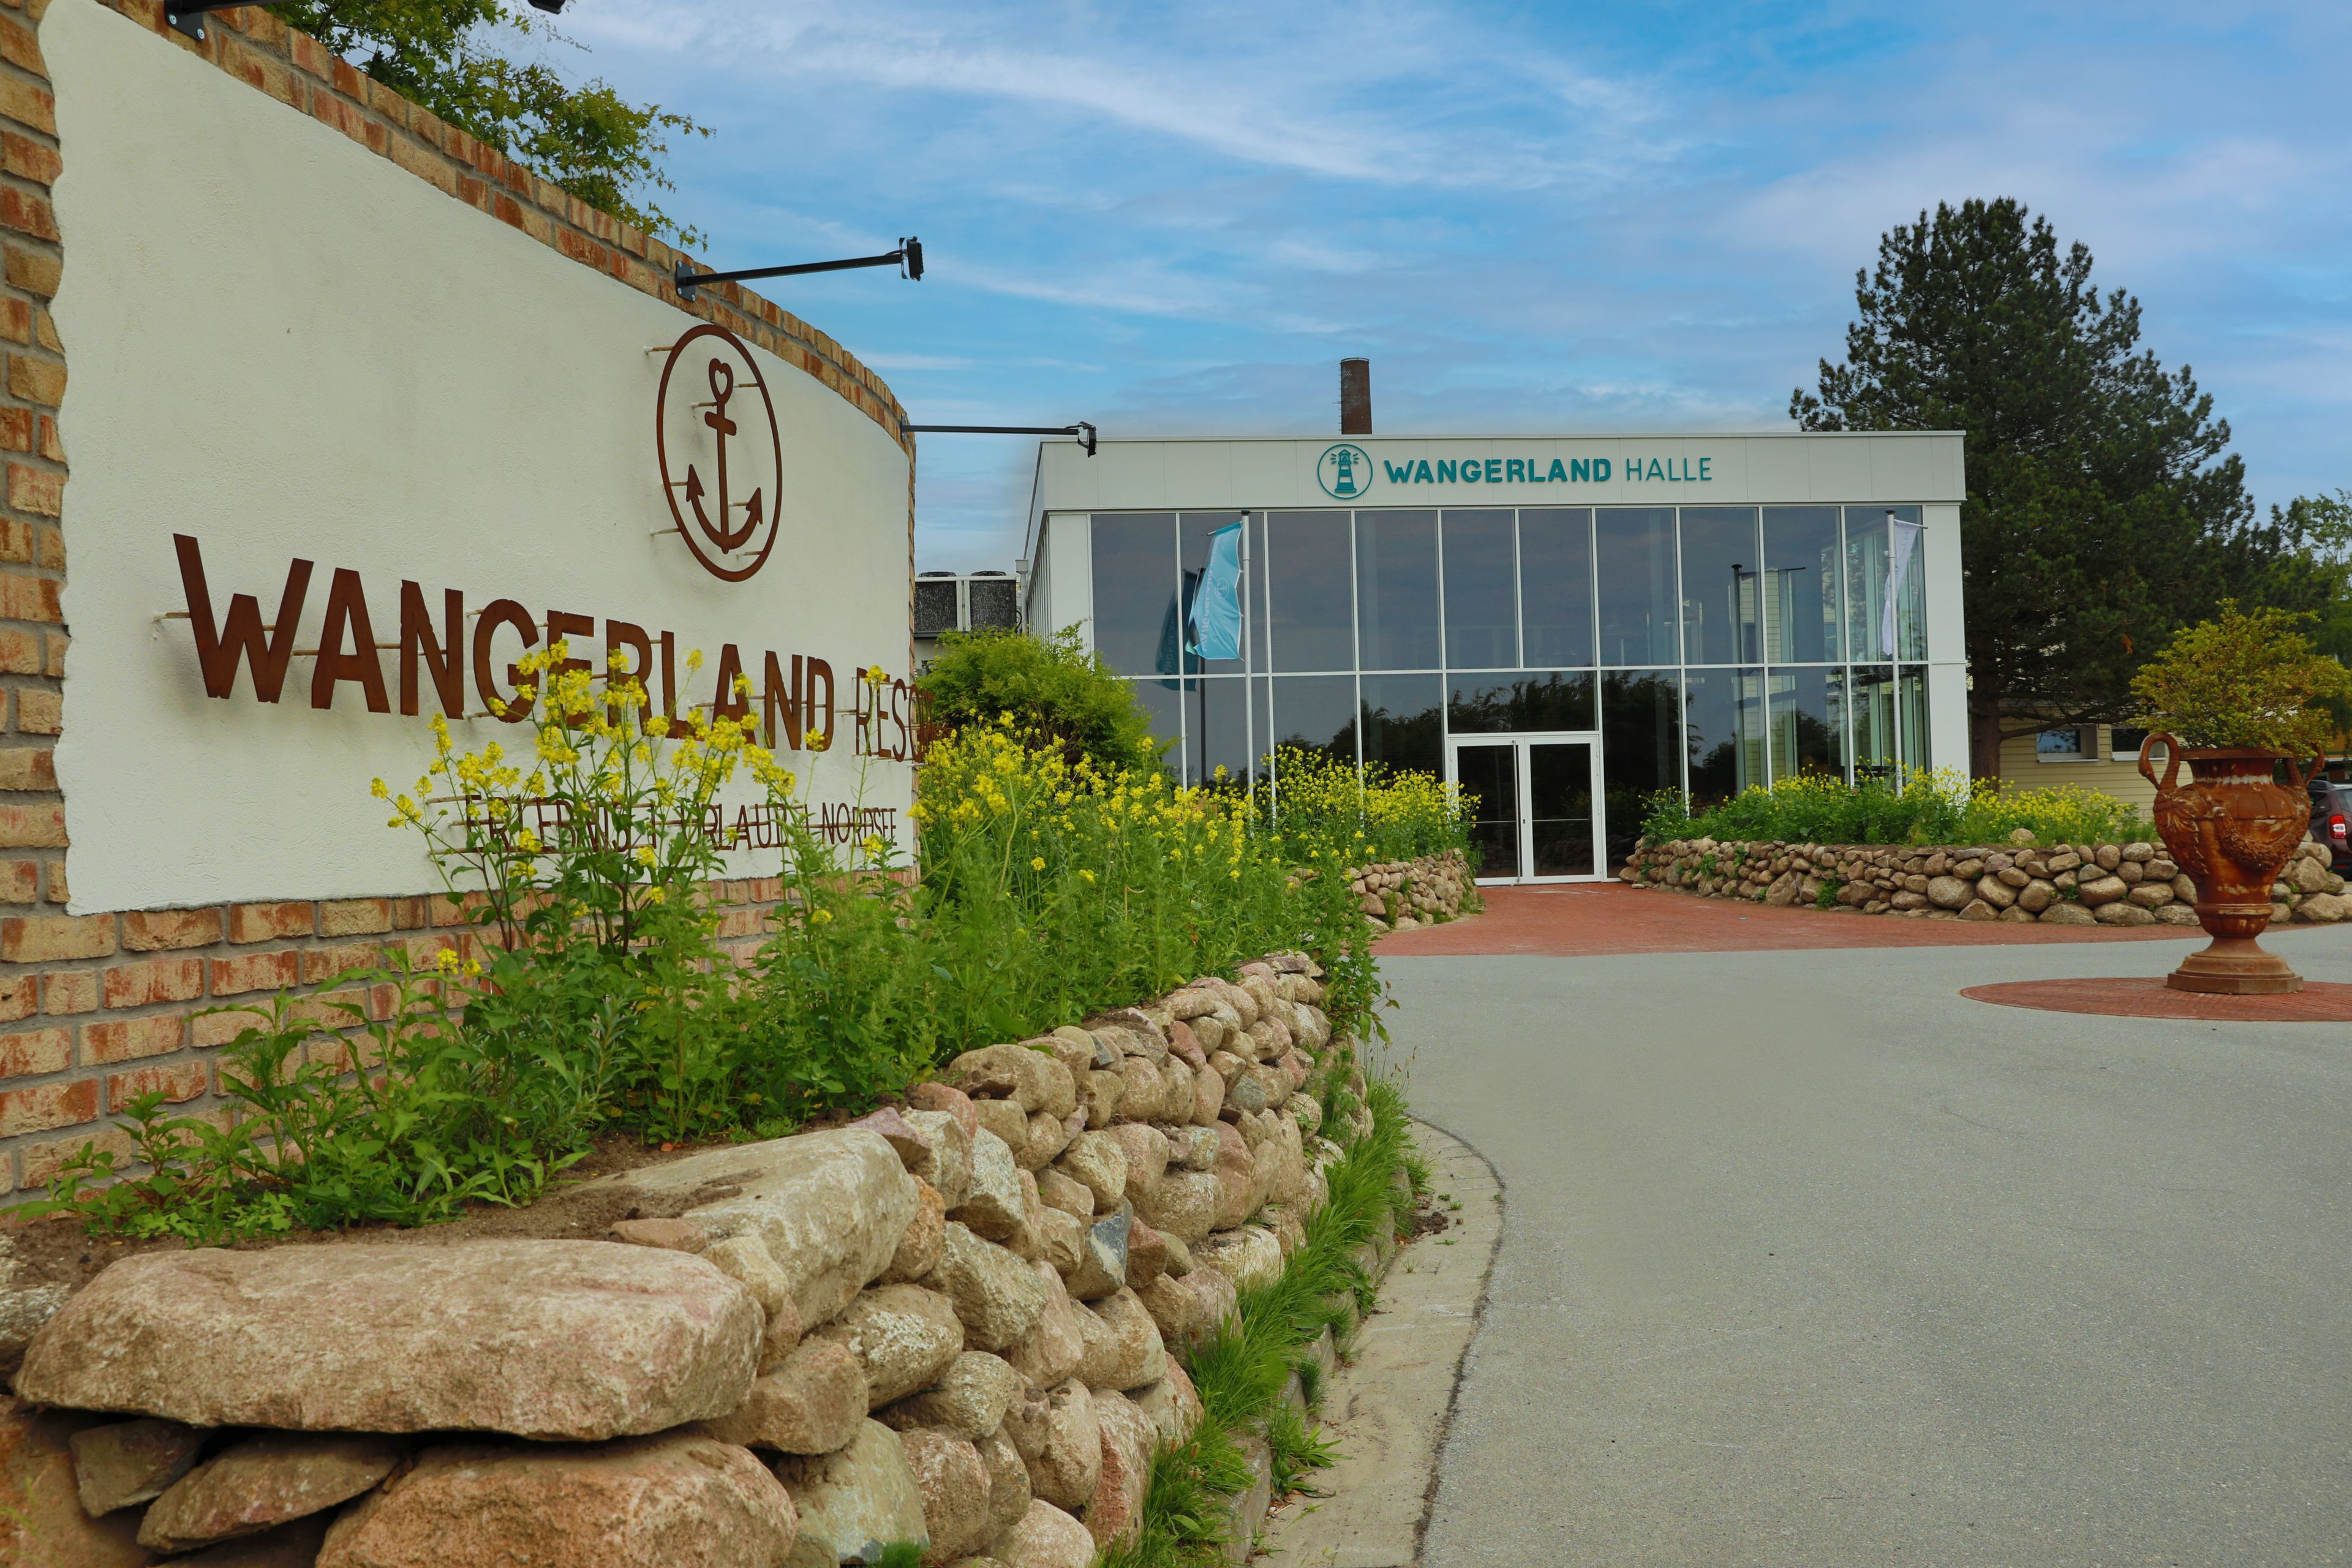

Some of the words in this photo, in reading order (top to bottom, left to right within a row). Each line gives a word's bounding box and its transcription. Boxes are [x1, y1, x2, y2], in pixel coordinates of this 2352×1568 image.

[1384, 458, 1611, 483] WANGERLAND
[1626, 457, 1713, 481] HALLE
[173, 532, 835, 753] WANGERLAND
[821, 802, 897, 848] NORDSEE
